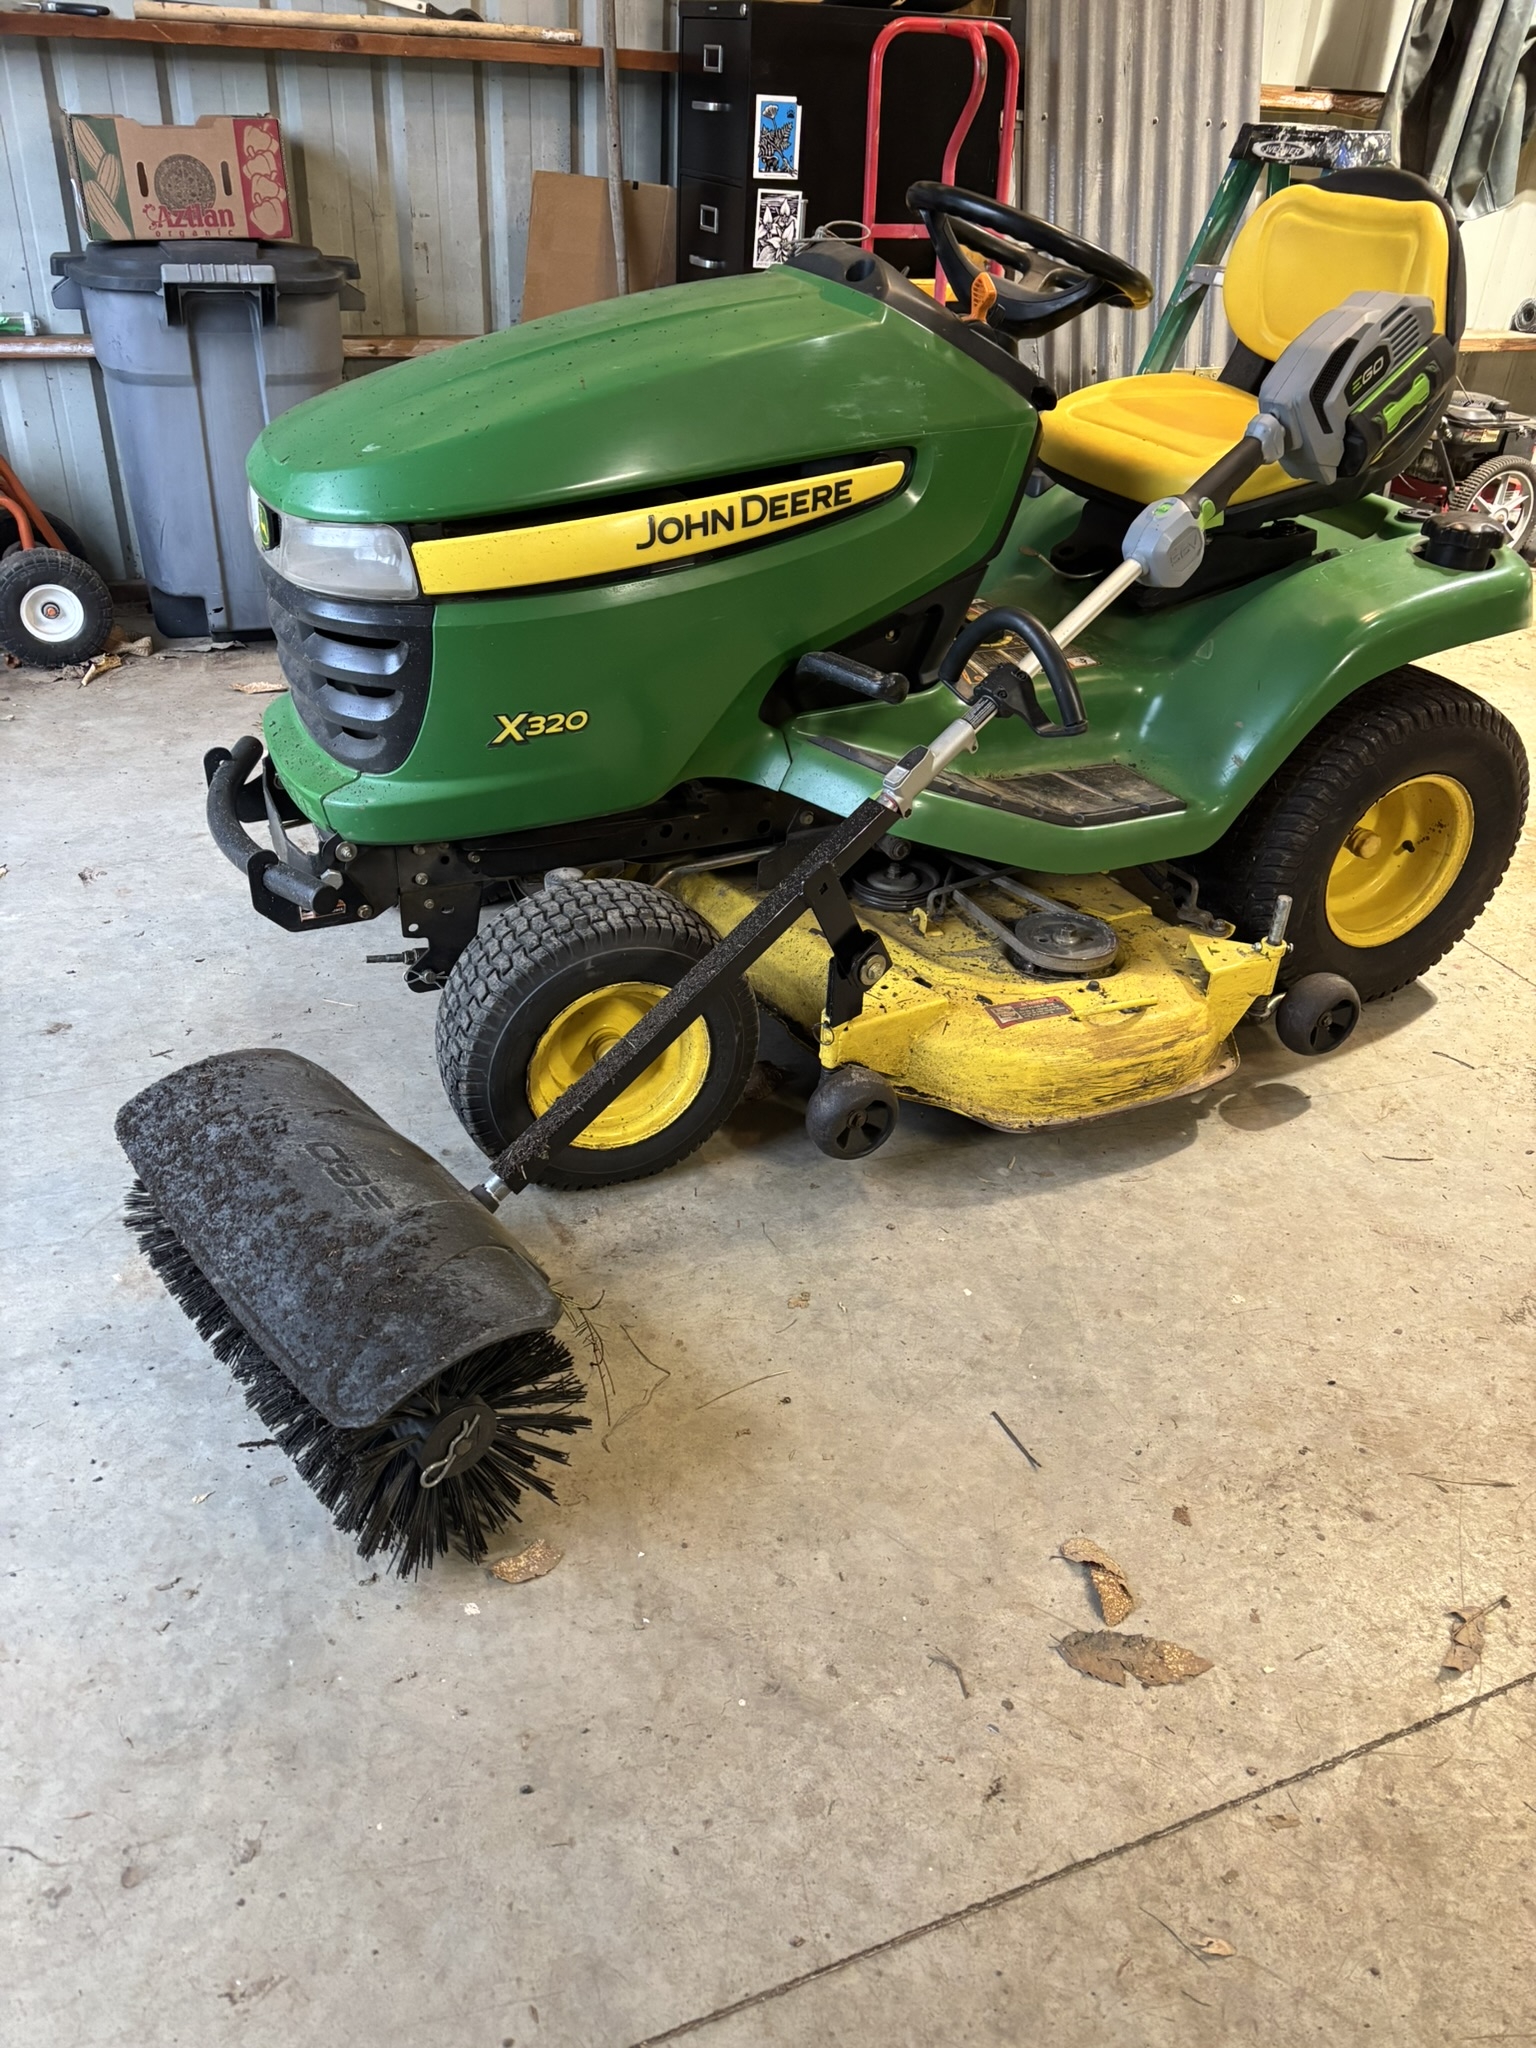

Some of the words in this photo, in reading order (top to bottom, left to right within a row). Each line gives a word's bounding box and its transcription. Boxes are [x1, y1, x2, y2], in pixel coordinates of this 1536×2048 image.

[155, 229, 235, 238] organic
[1352, 355, 1384, 395] EGO
[636, 504, 735, 550] JOHN
[740, 478, 853, 529] DEERE
[488, 711, 589, 748] X320
[304, 1141, 395, 1211] EGO
